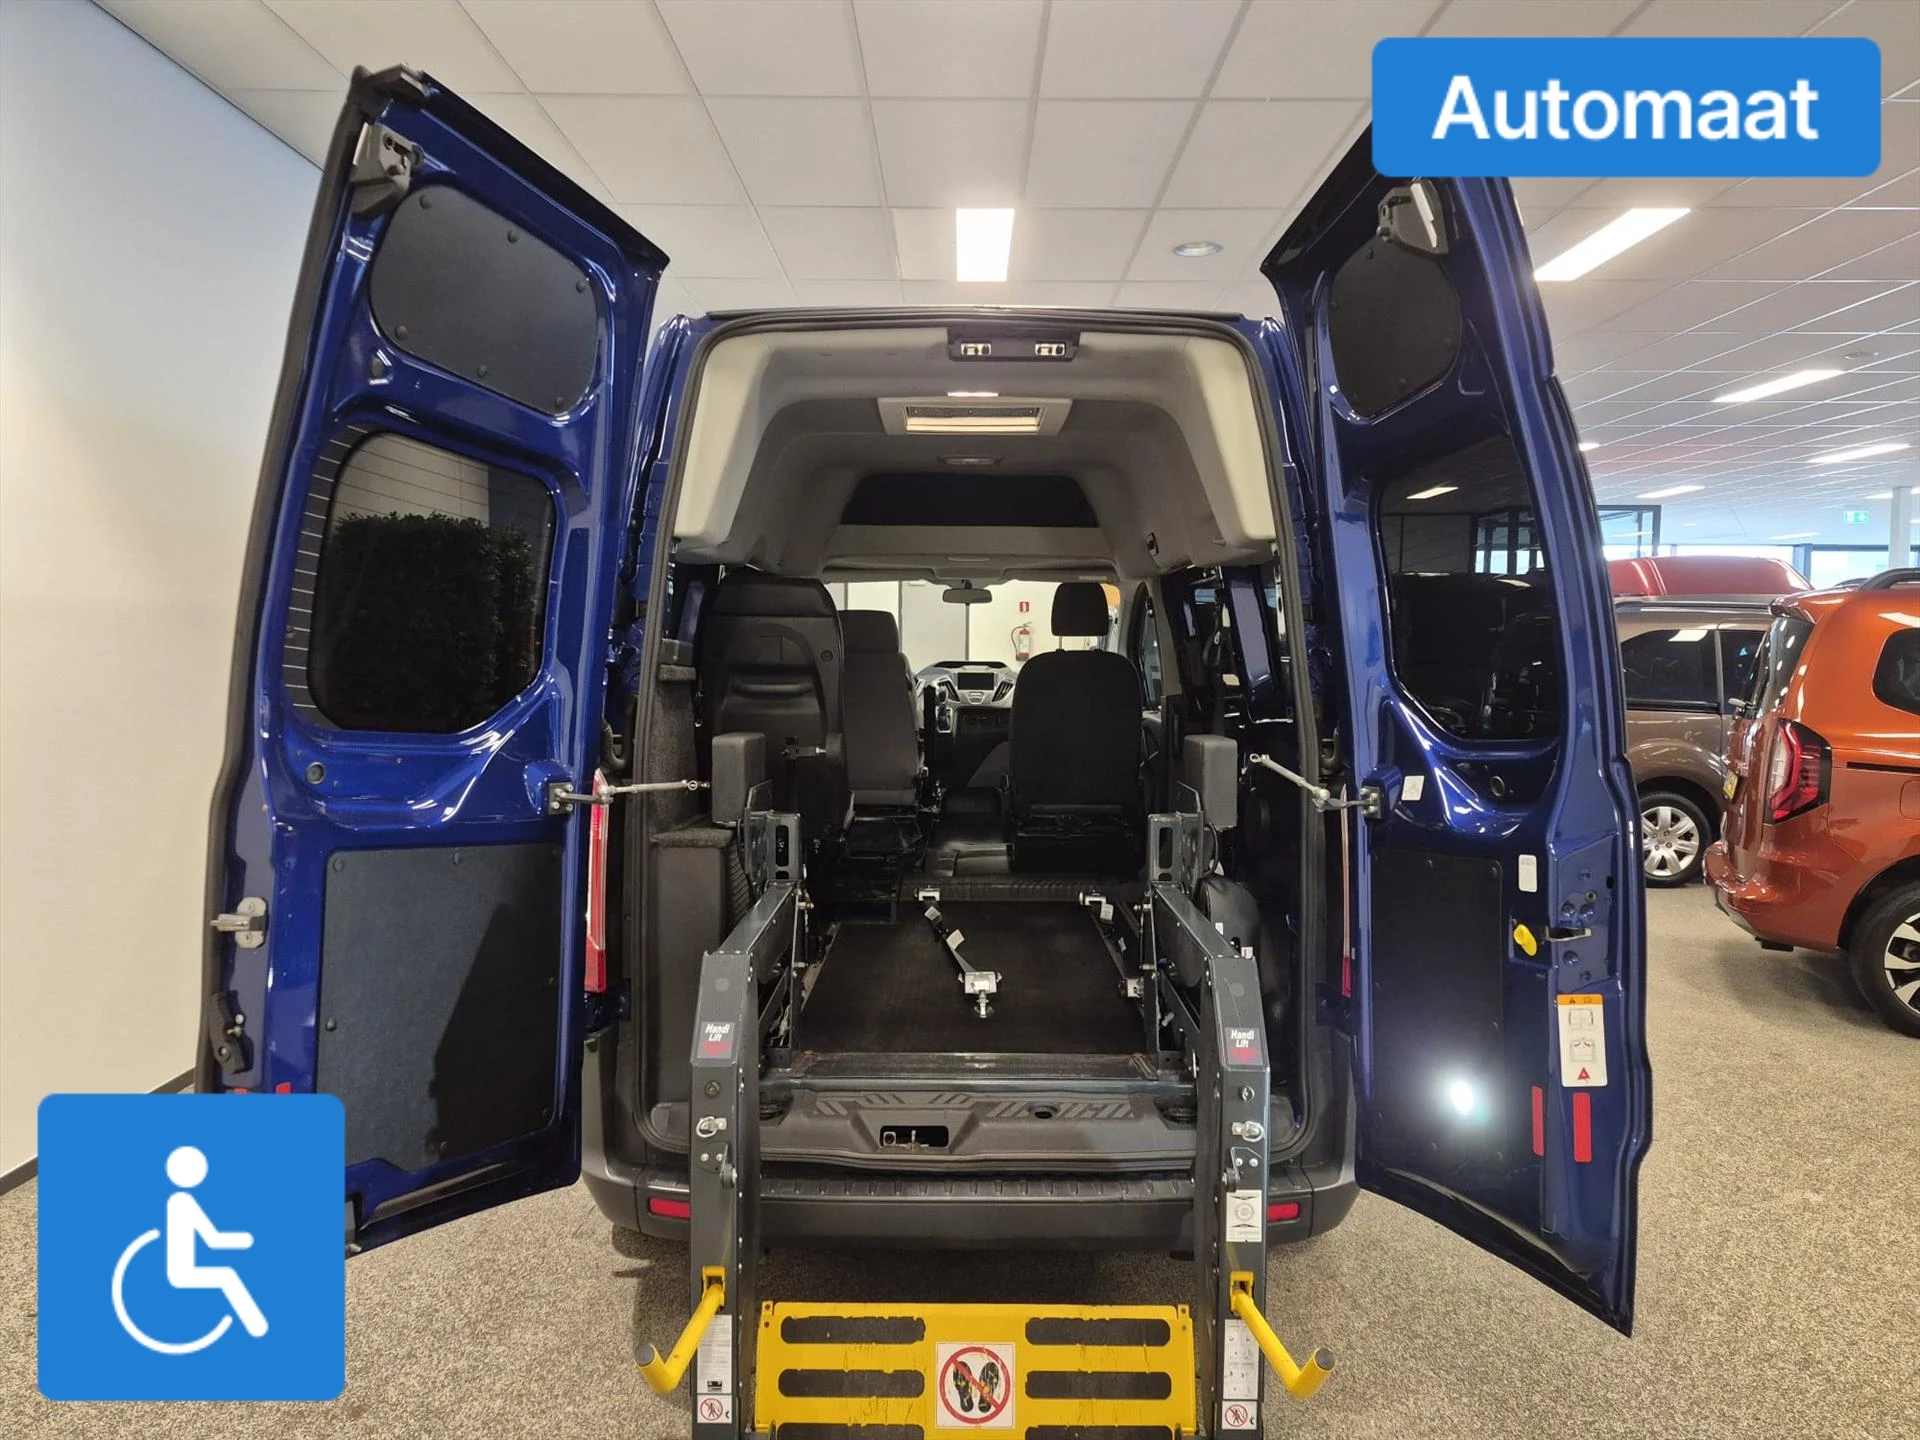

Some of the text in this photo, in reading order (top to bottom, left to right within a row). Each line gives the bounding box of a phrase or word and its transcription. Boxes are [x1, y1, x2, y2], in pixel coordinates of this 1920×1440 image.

[705, 1023, 730, 1034] Handi
[1231, 1029, 1255, 1040] Handi
[1235, 1039, 1249, 1048] Lift
